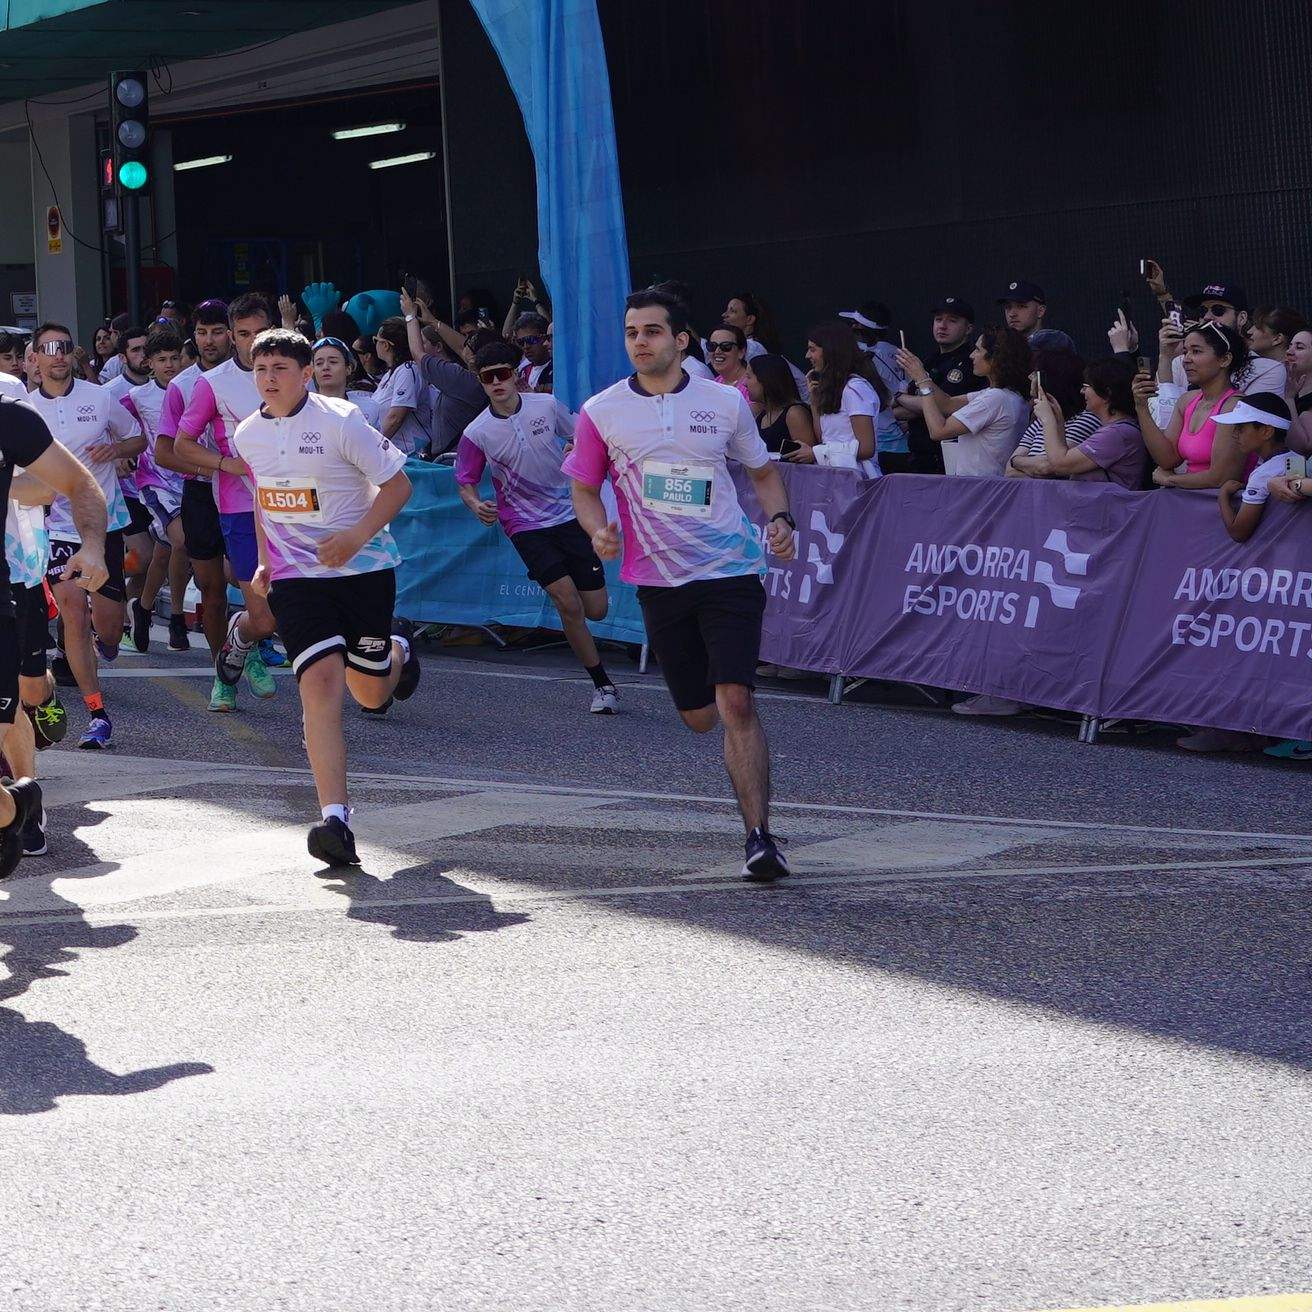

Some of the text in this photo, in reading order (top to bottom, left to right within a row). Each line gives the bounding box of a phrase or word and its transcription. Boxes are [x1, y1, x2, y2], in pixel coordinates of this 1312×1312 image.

[689, 424, 718, 435] MOU-TE
[298, 445, 325, 455] MOU-TE
[664, 477, 693, 494] 856
[265, 491, 308, 508] 1504
[662, 491, 693, 503] PAULO
[904, 542, 1032, 583] ANDORRA
[499, 584, 510, 596] EL
[1173, 565, 1312, 609] ANDORR
[902, 584, 1019, 625] ESPORTS
[1171, 612, 1312, 658] ESPORT
